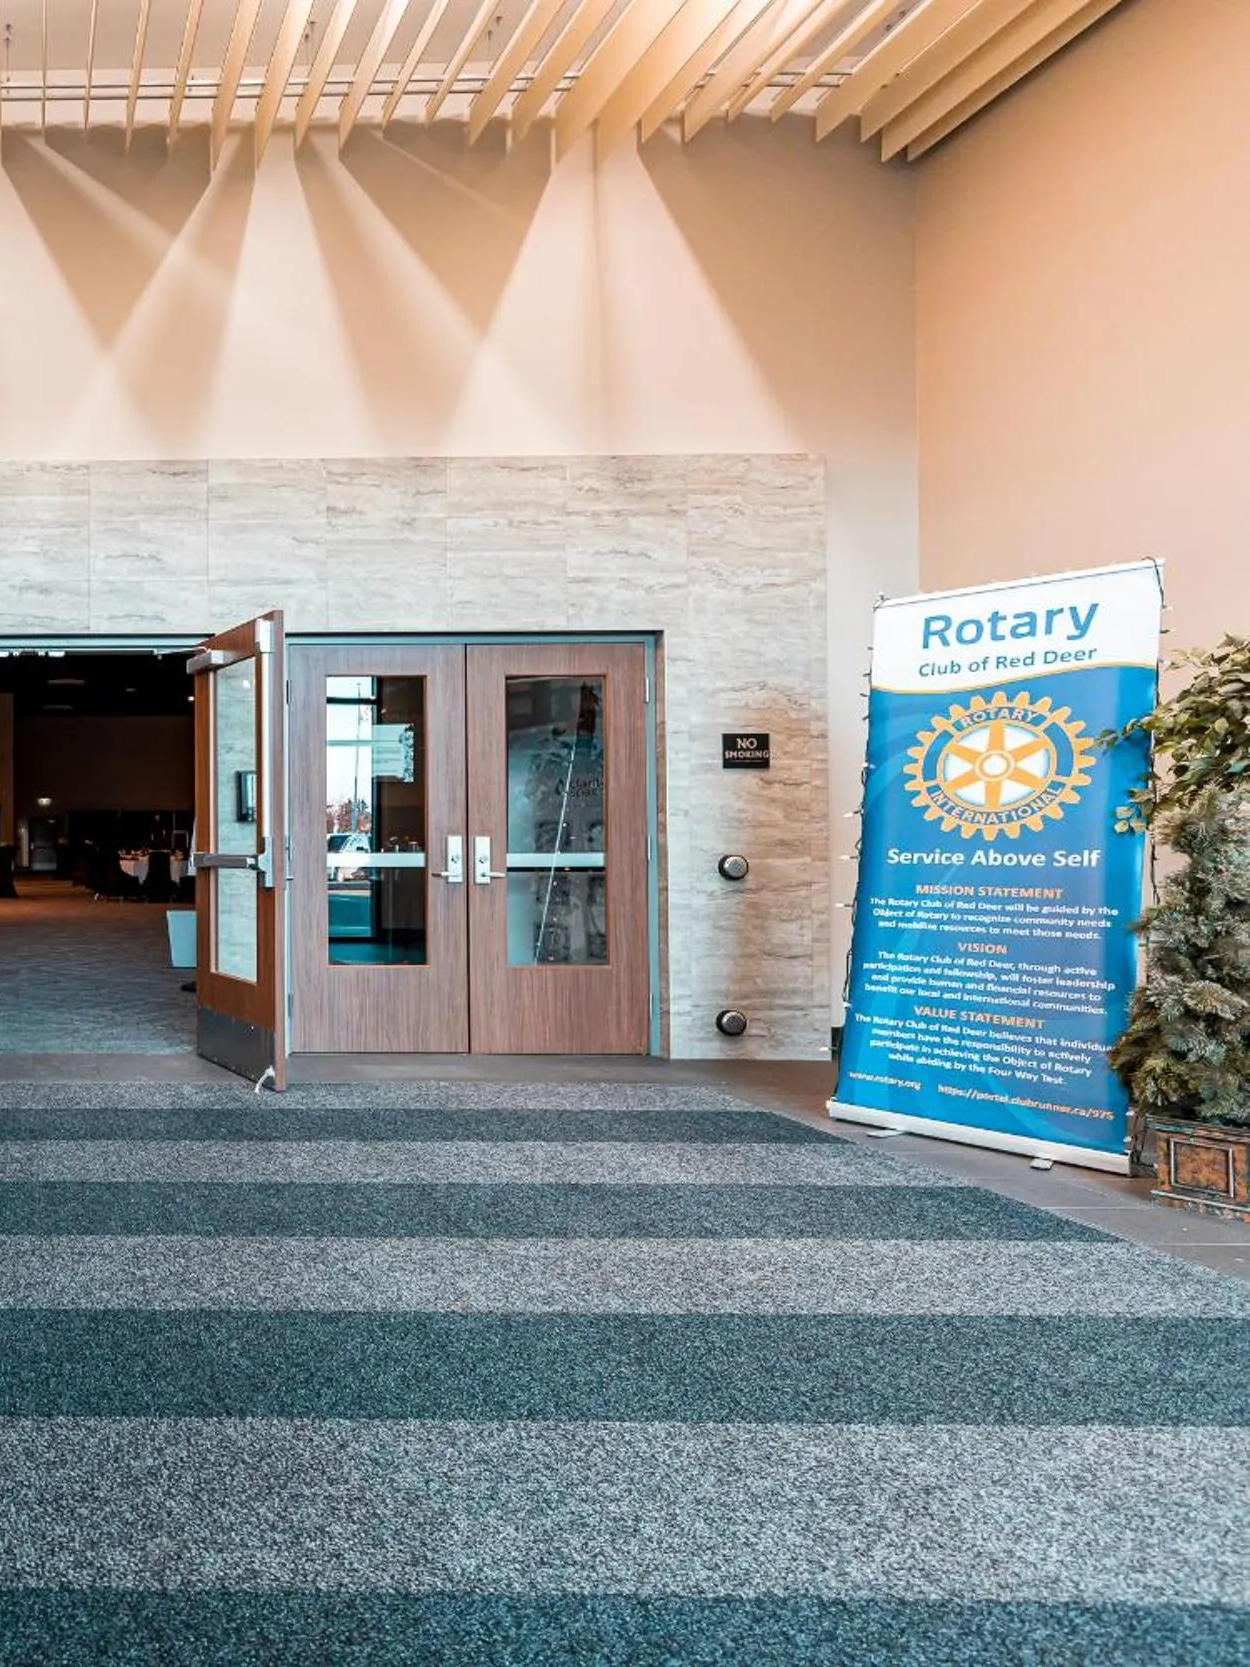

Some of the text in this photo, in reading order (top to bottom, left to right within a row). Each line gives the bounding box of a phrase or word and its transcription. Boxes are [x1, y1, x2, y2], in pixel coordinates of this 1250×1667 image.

[922, 602, 1099, 649] Rotary
[918, 647, 1098, 678] Club of Red Deer
[960, 708, 1038, 729] ROTARY
[736, 738, 758, 749] NO
[724, 750, 769, 759] SMOKING
[929, 785, 1064, 825] INTERNATIONAL
[886, 848, 1101, 867] Service Above Self
[916, 884, 1063, 899] MISSION STATEMENT
[870, 897, 885, 905] The
[888, 898, 918, 908] Rotary
[921, 900, 942, 908] Club
[945, 900, 954, 908] of
[956, 901, 976, 909] Red
[978, 902, 1002, 911] Deer
[1026, 904, 1039, 912] be
[1041, 905, 1079, 914] guided
[1081, 906, 1096, 916] by
[1098, 906, 1119, 916] the
[872, 908, 903, 918] Object
[905, 909, 915, 917] of
[917, 910, 949, 921] Rotary
[951, 912, 961, 920] to
[1014, 916, 1075, 928] community
[1077, 918, 1112, 928] needs
[878, 920, 896, 928] and
[989, 926, 1001, 934] to
[1003, 928, 1030, 936] meet
[1032, 928, 1062, 938] those
[957, 942, 1008, 955] VISION
[878, 951, 895, 959] The
[897, 953, 929, 964] Rotary
[930, 955, 952, 964] Club
[953, 957, 965, 965] of
[966, 958, 987, 967] Red
[1018, 961, 1061, 974] through
[1063, 967, 1098, 976] active
[871, 973, 889, 981] and
[964, 982, 984, 991] and
[1033, 989, 1086, 1000] resources
[1089, 992, 1101, 1001] to
[923, 967, 942, 975] and
[1001, 973, 1019, 982] will
[1021, 975, 1054, 984] foster
[1056, 977, 1116, 991] leadership
[899, 987, 915, 995] our
[942, 992, 961, 1001] and
[913, 1005, 1045, 1029] VALUE STATEMENT
[854, 1013, 871, 1022] The
[873, 1016, 903, 1027] Rotary
[905, 1020, 927, 1029] Club
[928, 1023, 939, 1031] of
[941, 1024, 961, 1034] Red
[963, 1027, 987, 1037] Deer
[989, 1030, 1032, 1042] believes
[1034, 1036, 1057, 1046] that
[918, 1033, 940, 1042] have
[943, 1036, 959, 1045] the
[1034, 1048, 1045, 1056] to
[1048, 1051, 1091, 1064] actively
[921, 1045, 931, 1053] in
[933, 1047, 980, 1061] achieving
[983, 1053, 1000, 1062] the
[1003, 1056, 1037, 1068] Object
[1040, 1062, 1052, 1070] of
[1055, 1063, 1092, 1077] Rotary
[954, 1062, 966, 1071] by
[969, 1063, 986, 1073] the
[988, 1066, 1012, 1076] Four
[1015, 1070, 1039, 1082] Way
